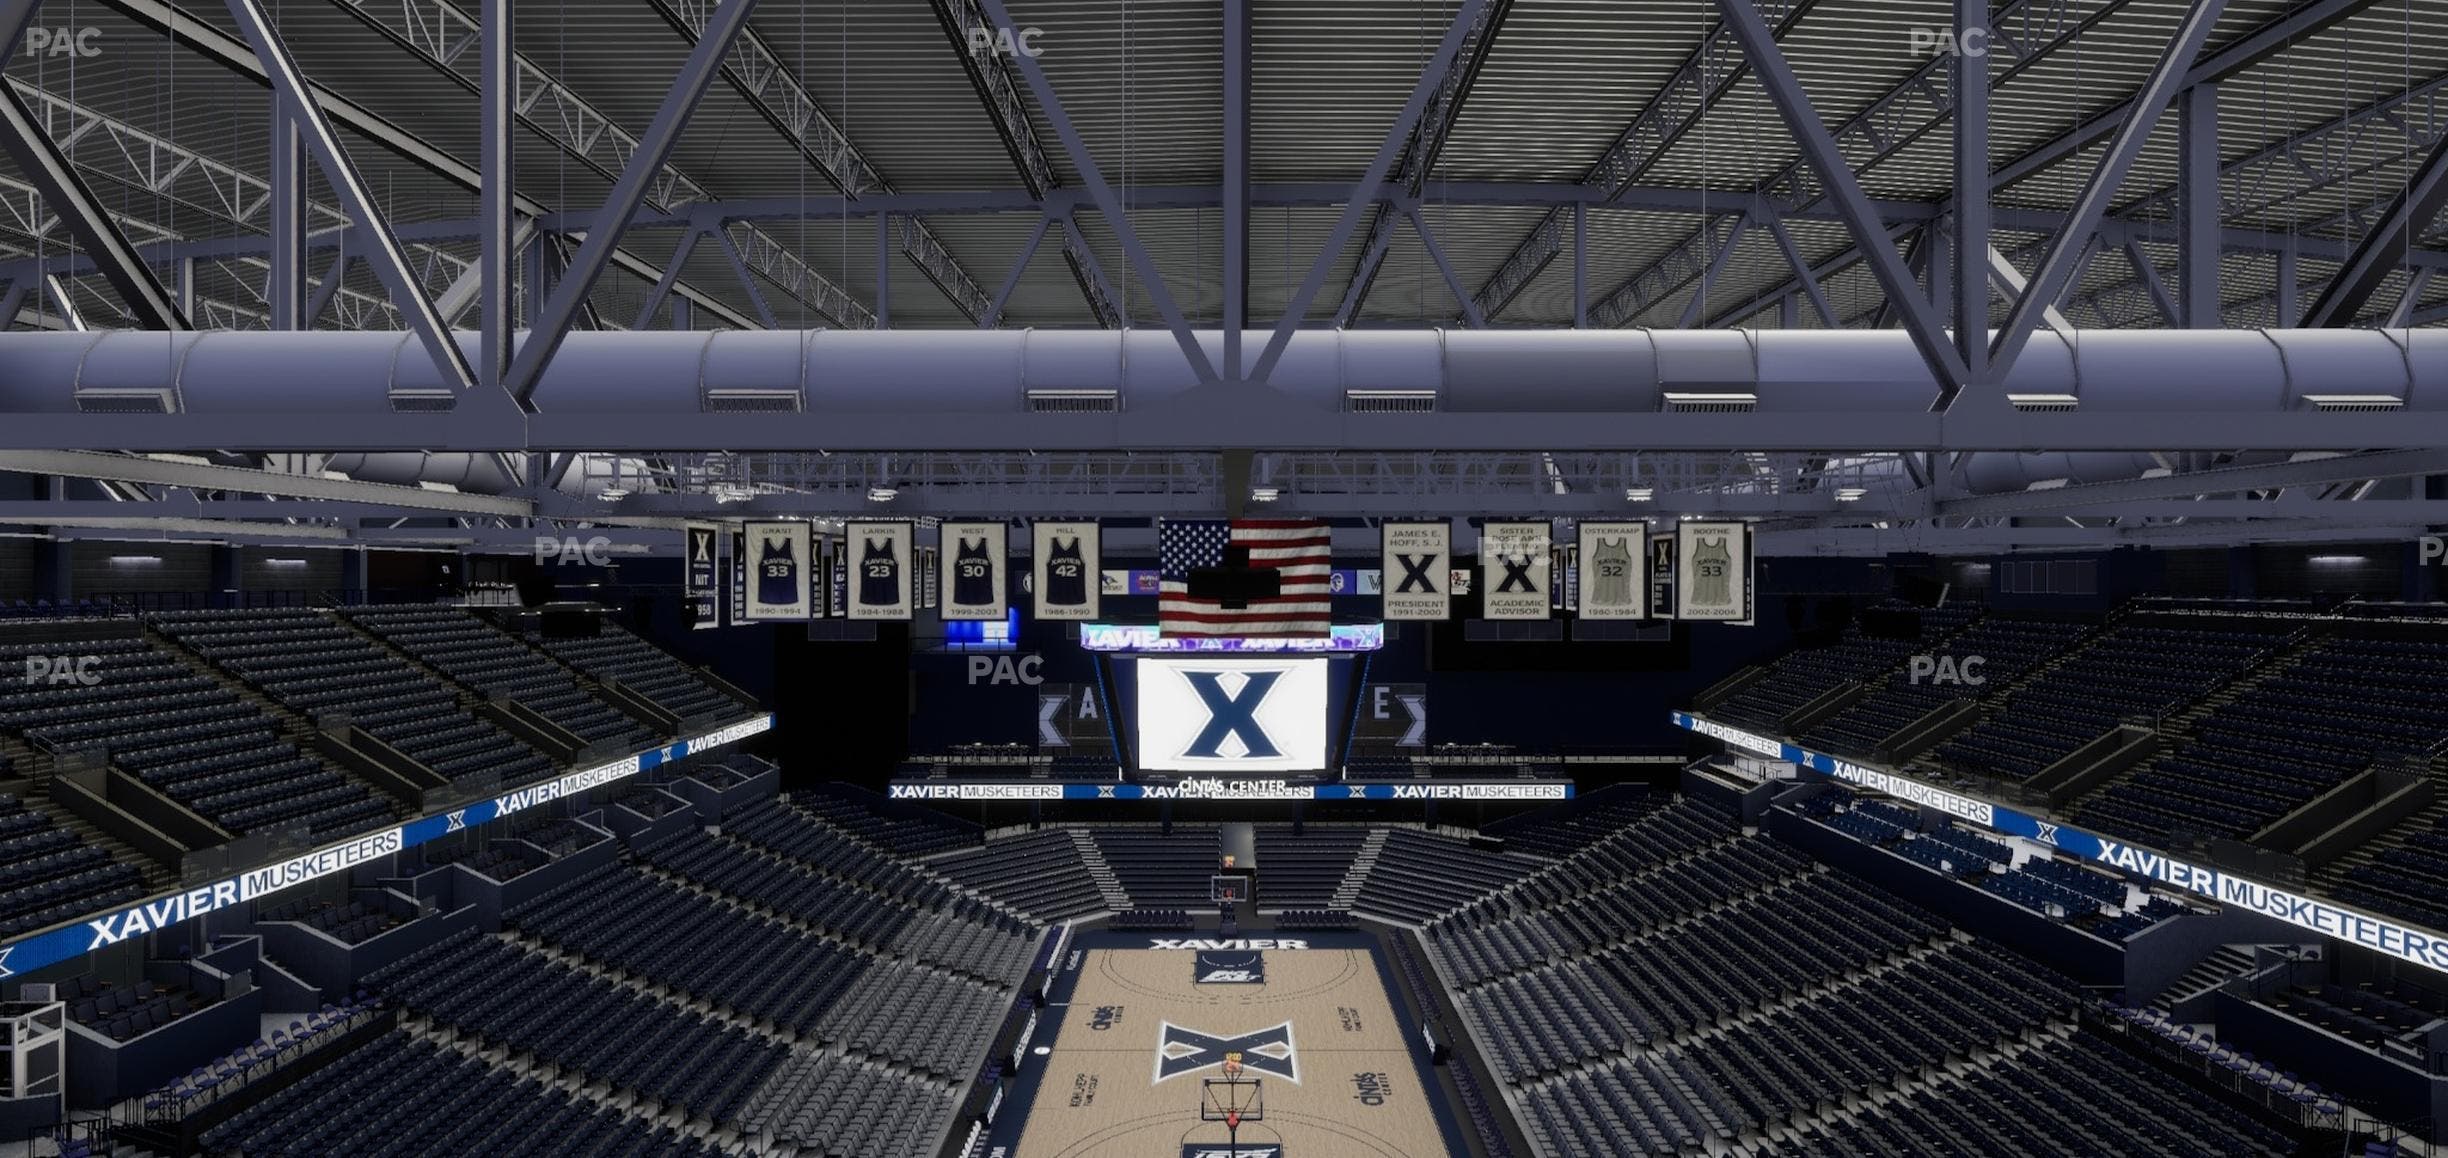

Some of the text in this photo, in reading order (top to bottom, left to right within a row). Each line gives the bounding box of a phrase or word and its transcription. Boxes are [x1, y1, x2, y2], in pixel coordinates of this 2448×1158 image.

[762, 527, 794, 536] GRANT
[863, 527, 896, 535] LARKIN
[961, 527, 986, 535] WEST
[1056, 527, 1076, 535] HILL
[1392, 529, 1441, 538] JAMES E.
[1584, 528, 1641, 536] OSTERKAMP
[1693, 528, 1731, 536] BOOTHE
[767, 565, 789, 578] 33
[869, 565, 891, 578] 23
[963, 565, 985, 578] 30
[1057, 565, 1079, 578] 42
[1601, 565, 1623, 578] 32
[1701, 565, 1723, 578] 33
[1387, 600, 1445, 609] PRESIDENT
[1489, 600, 1545, 608] ACADEMIC
[1392, 609, 1443, 617] 1991-2000
[1494, 608, 1541, 616] ADVISOR
[1686, 609, 1736, 617] 2002-2006
[1176, 667, 1293, 760] X
[1692, 717, 1724, 742] XAVIER
[890, 786, 960, 799] XAVIER
[963, 786, 1062, 799] MUSKETEERS
[1393, 786, 1461, 799] XAVIER
[1464, 786, 1563, 799] MUSKETEERS
[1230, 780, 1286, 793] CENTER
[1832, 760, 1890, 791] XAVIER
[1892, 778, 1990, 822] MUSKETEERS
[87, 880, 236, 951] XAVIER
[249, 832, 399, 898] MUSKETEERS
[495, 782, 560, 818] XAVIER
[564, 757, 639, 795] MUSKETEERS
[686, 731, 723, 755] XAVIER
[2097, 838, 2217, 898] XAVIER
[2224, 877, 2448, 975] MUSKETEERS
[1148, 939, 1310, 950] XAVIER
